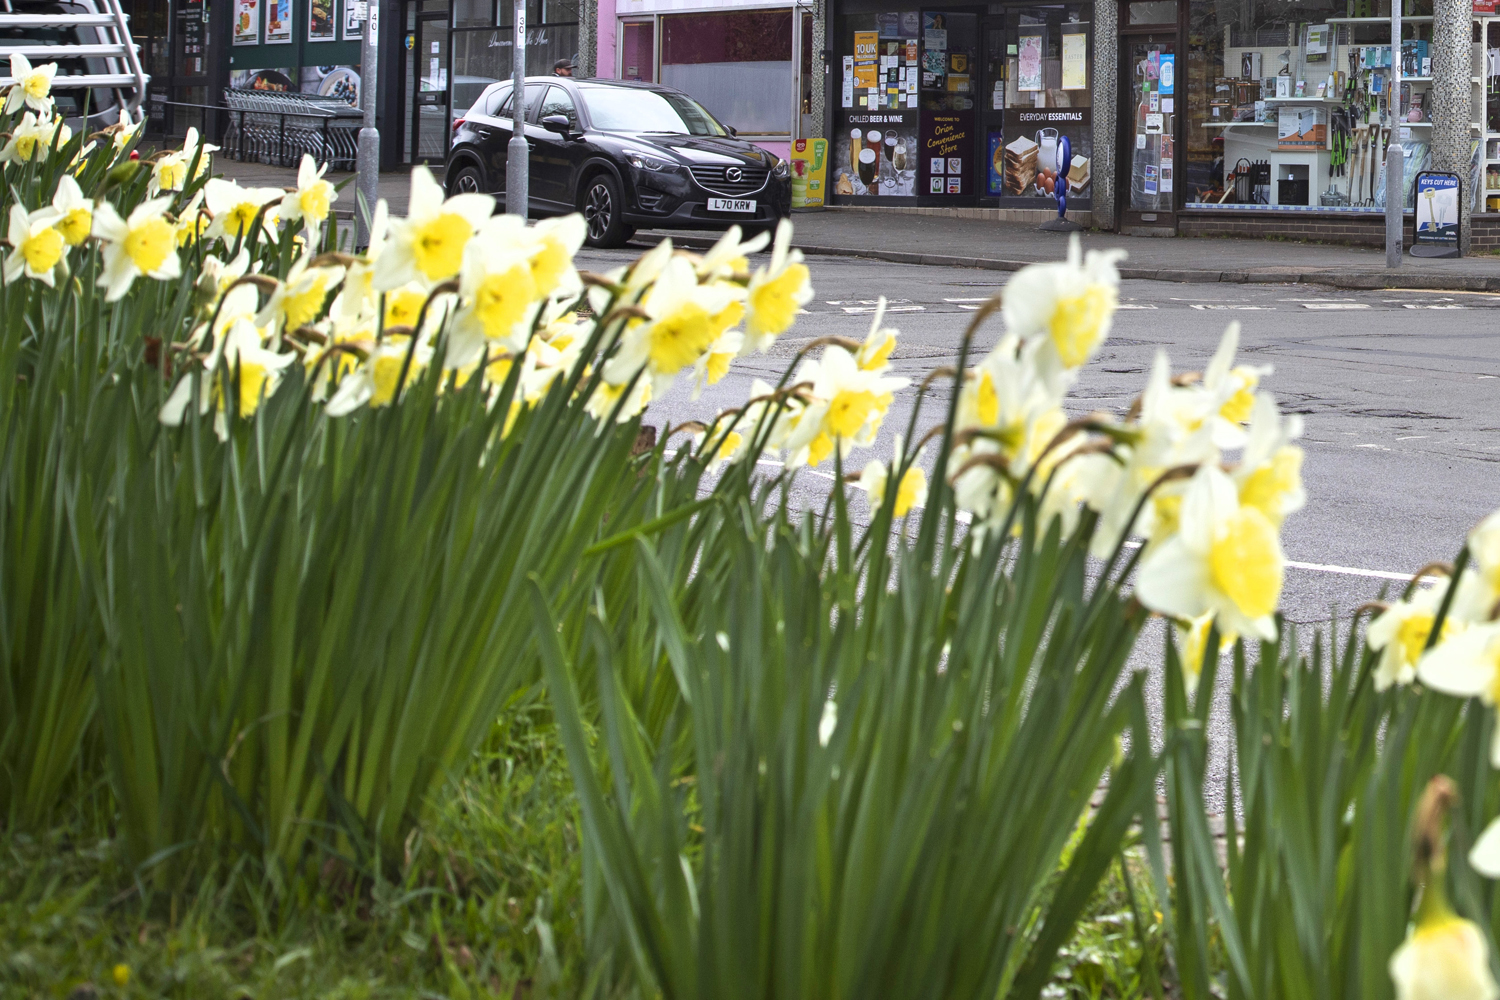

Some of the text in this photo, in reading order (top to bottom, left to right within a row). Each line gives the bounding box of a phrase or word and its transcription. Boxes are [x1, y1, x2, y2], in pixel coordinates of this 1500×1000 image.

[856, 43, 876, 54] 10 UK
[1020, 113, 1047, 121] EVERYDAY
[935, 124, 953, 135] Orion
[927, 132, 965, 148] Convenience
[939, 144, 958, 155] Store
[714, 200, 750, 210] L70 KRW
